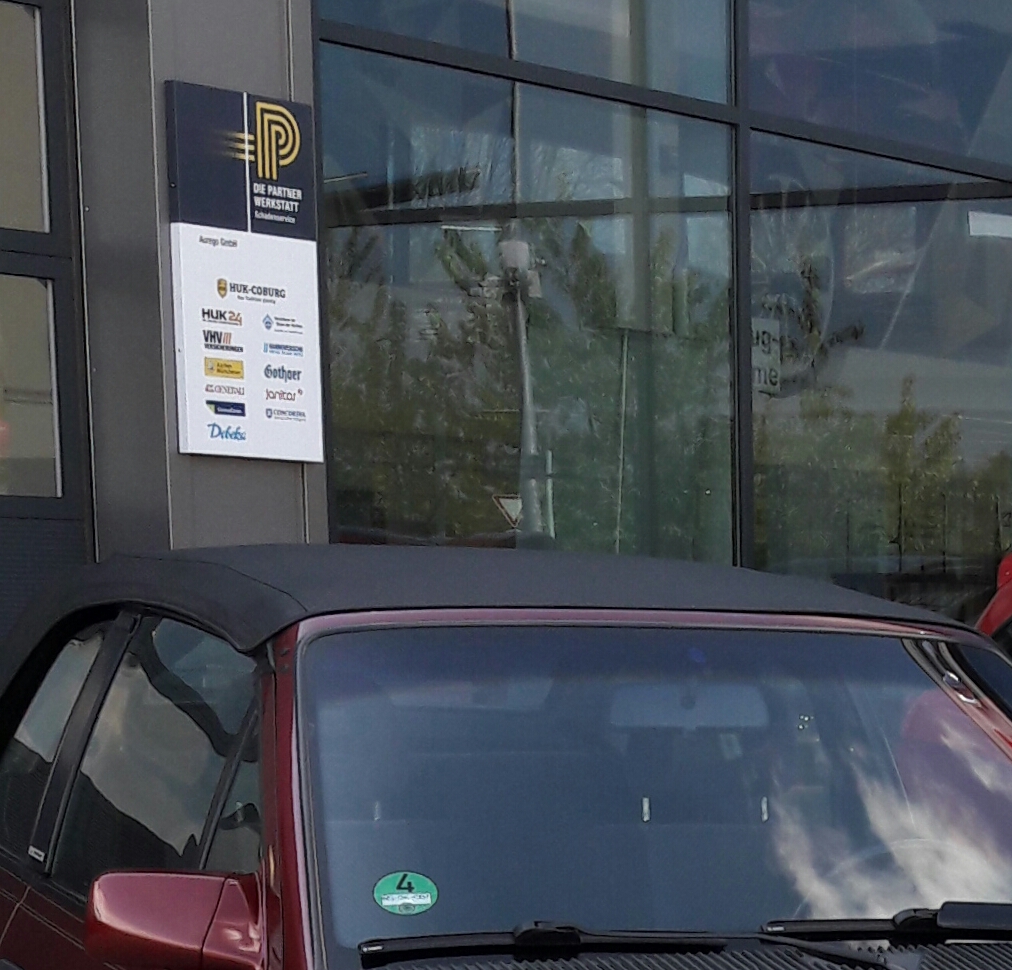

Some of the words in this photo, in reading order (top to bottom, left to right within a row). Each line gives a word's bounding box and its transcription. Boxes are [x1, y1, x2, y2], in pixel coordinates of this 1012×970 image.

[253, 182, 266, 195] DIE
[267, 184, 302, 200] PARTNER
[254, 196, 299, 213] WERKSTATT
[229, 282, 286, 299] HUK-COBURG
[202, 329, 223, 345] VHV
[264, 364, 302, 383] Gothaer
[396, 873, 415, 893] 4
